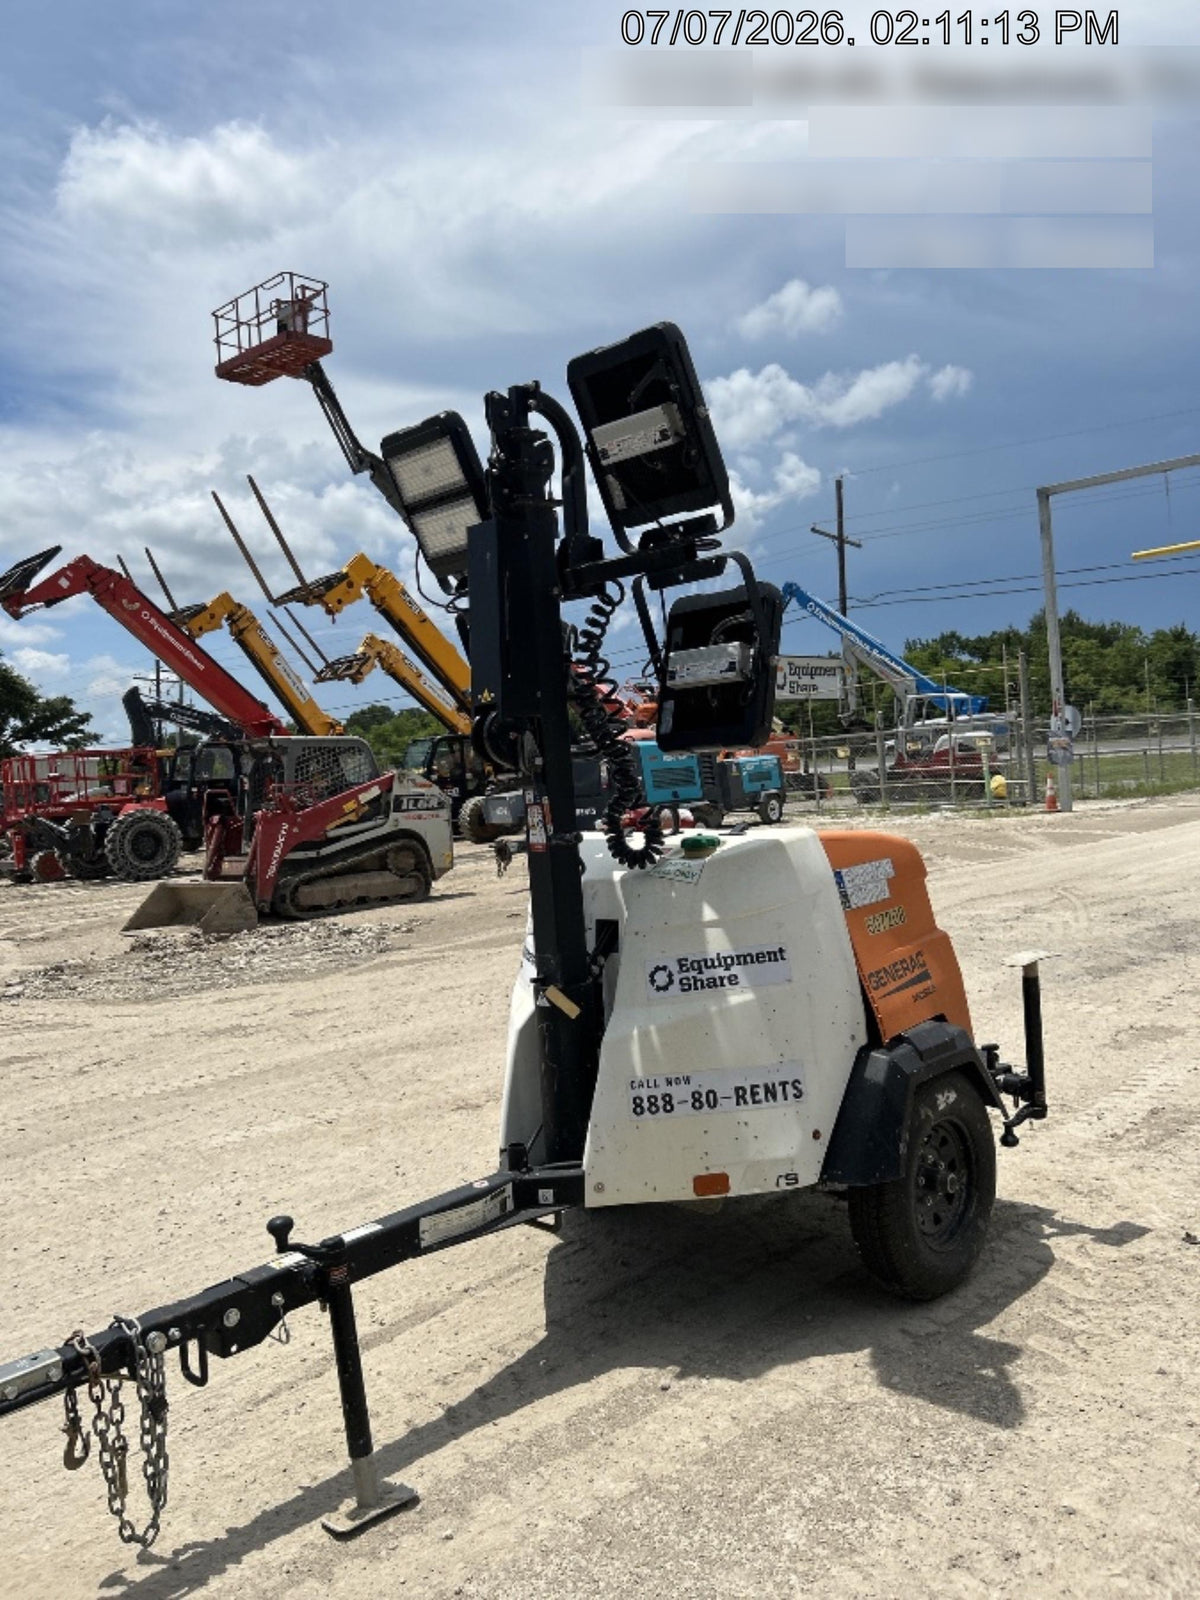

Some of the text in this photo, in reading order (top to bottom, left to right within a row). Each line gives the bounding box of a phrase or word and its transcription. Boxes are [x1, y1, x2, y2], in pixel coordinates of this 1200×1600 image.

[677, 947, 787, 975] Equipment
[867, 950, 928, 991] GENERAC
[678, 973, 740, 992] Share
[630, 1075, 692, 1090] CALL NOW
[632, 1079, 804, 1117] 888-80-RENTS
